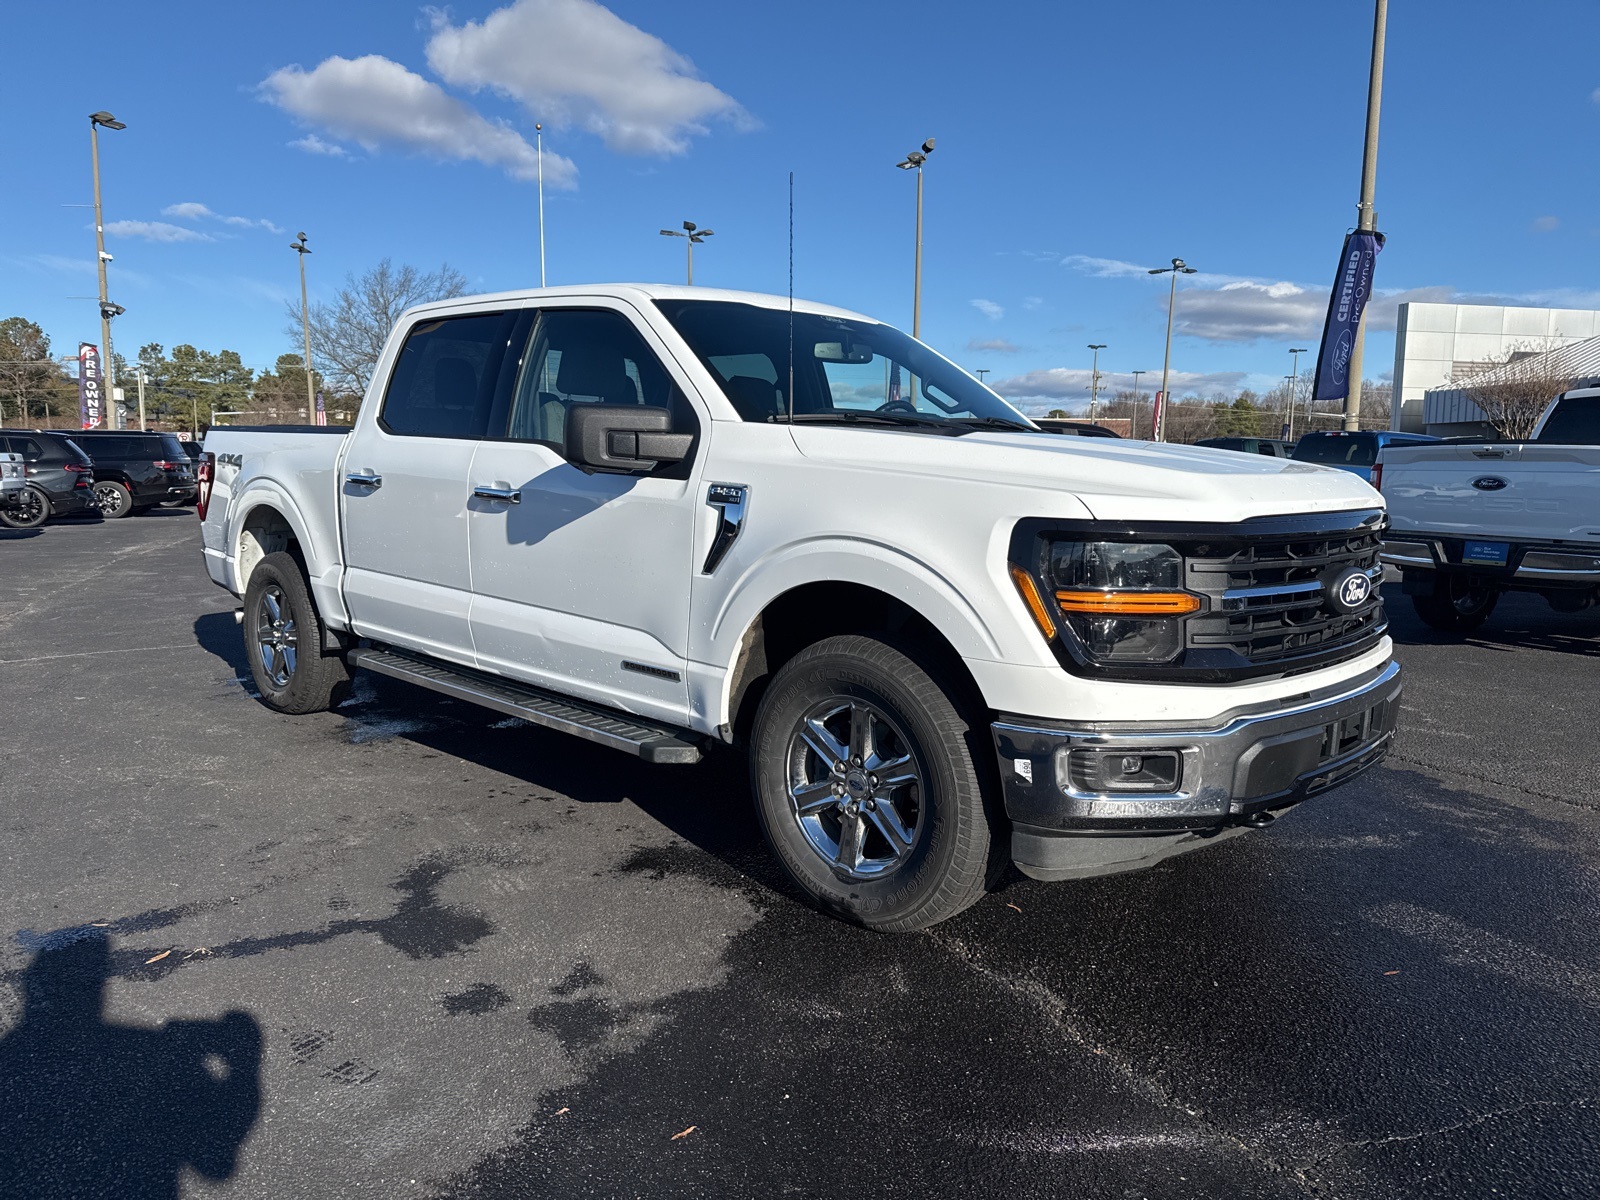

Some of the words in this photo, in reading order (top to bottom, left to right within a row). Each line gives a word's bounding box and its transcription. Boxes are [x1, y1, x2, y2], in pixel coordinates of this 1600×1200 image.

[1337, 250, 1361, 322] CERTIFIED
[1351, 250, 1373, 323] Pre-Owned
[85, 350, 97, 378] PRE
[1333, 341, 1350, 374] Ford
[85, 380, 99, 425] OWNED
[1345, 578, 1366, 602] Ford
[625, 662, 677, 679] POWERBOOST
[886, 816, 946, 906] Firestone
